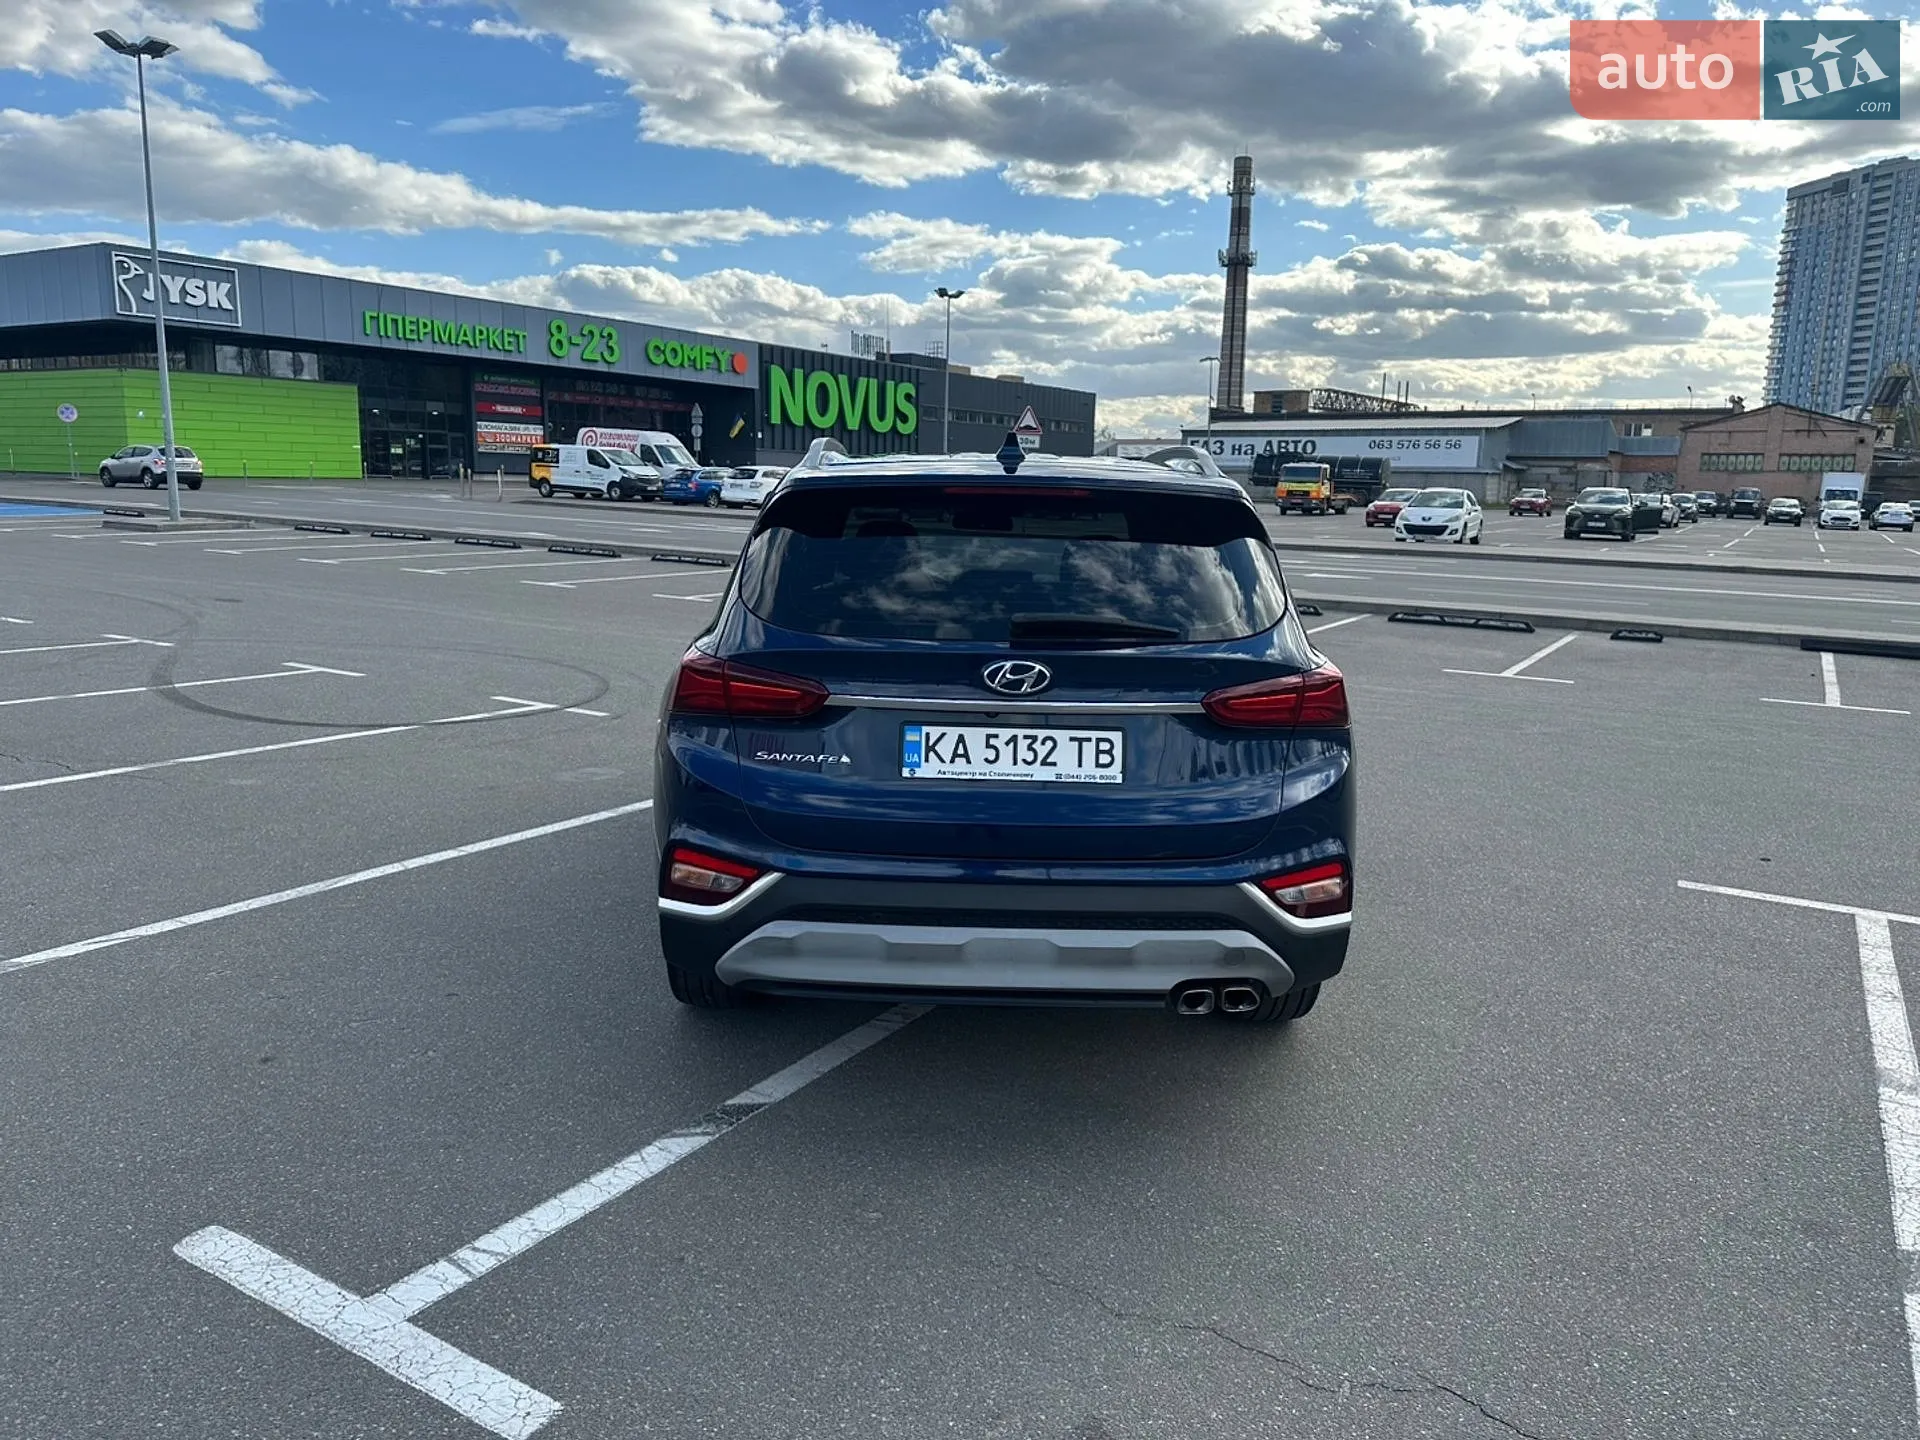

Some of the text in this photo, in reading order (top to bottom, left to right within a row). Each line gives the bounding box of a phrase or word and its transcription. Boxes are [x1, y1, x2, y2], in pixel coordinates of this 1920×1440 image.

[363, 310, 527, 353] ГІПЕРМАРКЕТ
[549, 319, 621, 364] 8-23
[646, 337, 733, 373] COMFY
[769, 364, 917, 435] NOVUS
[1231, 443, 1256, 456] на
[1261, 439, 1317, 456] АВТО
[1368, 439, 1462, 450] 063 576 56 56
[904, 753, 920, 763] UA
[924, 731, 1115, 769] KA 5132 TB
